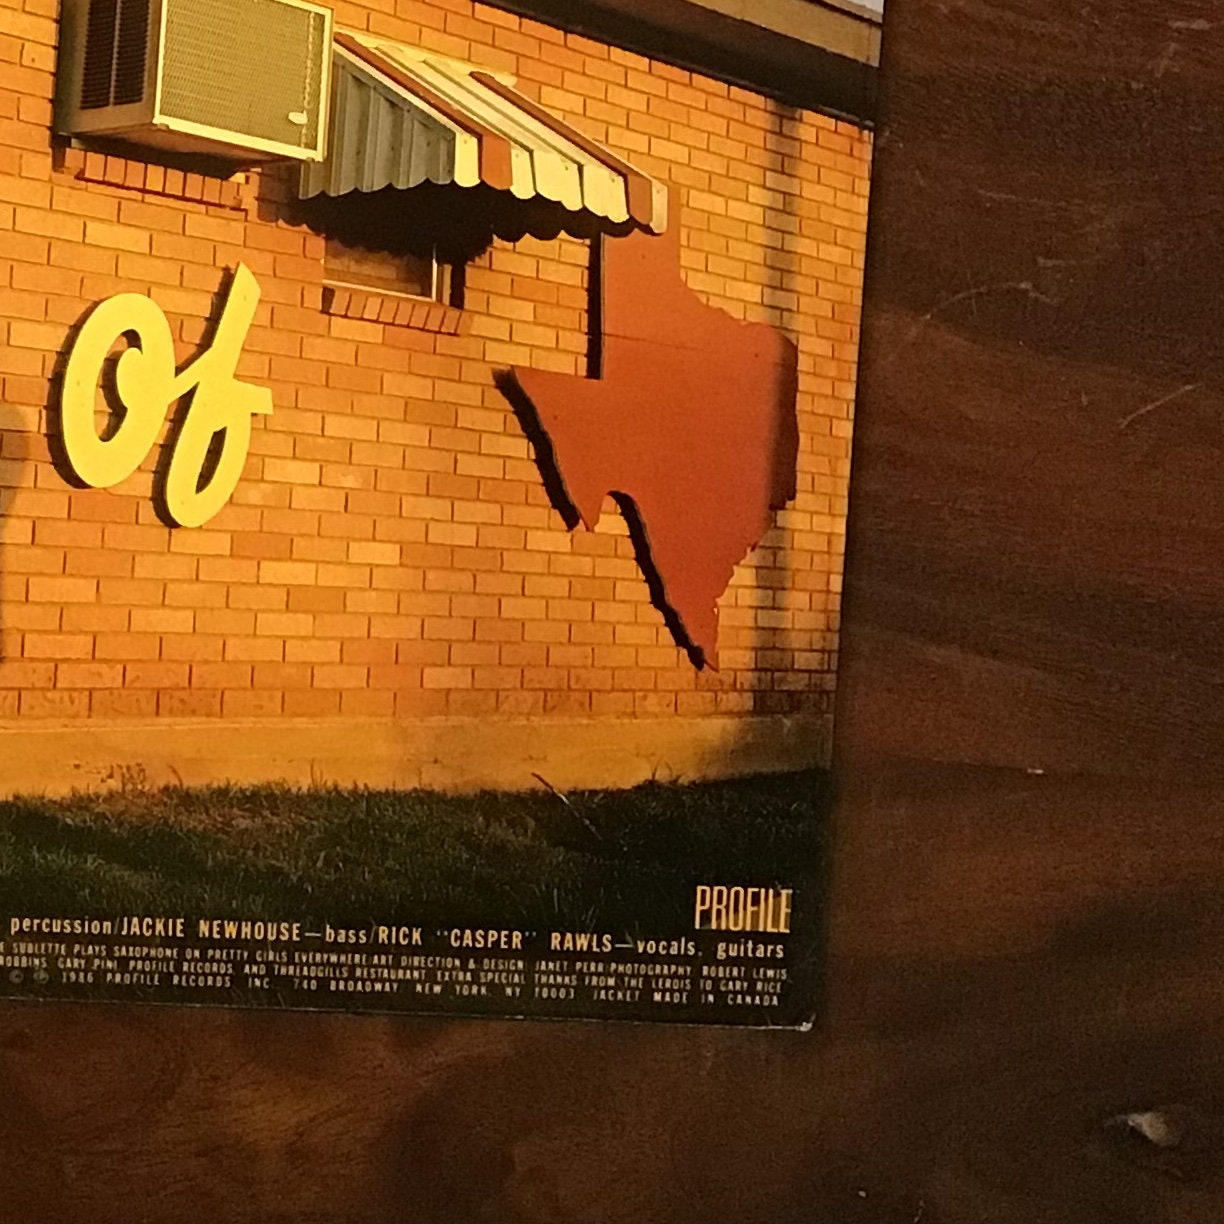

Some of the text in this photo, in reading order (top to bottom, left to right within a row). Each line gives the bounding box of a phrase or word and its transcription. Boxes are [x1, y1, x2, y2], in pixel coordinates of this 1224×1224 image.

[60, 262, 274, 529] Of
[694, 885, 793, 934] PROFILE
[73, 943, 107, 957] PLAYS
[113, 944, 178, 959] SAXOPHONE
[185, 947, 200, 960] ON
[753, 967, 787, 981] LEWIS
[716, 938, 785, 960] guitars
[624, 975, 644, 988] THE
[699, 978, 713, 991] TO
[653, 990, 688, 1003] MADE
[701, 992, 715, 1004] IN
